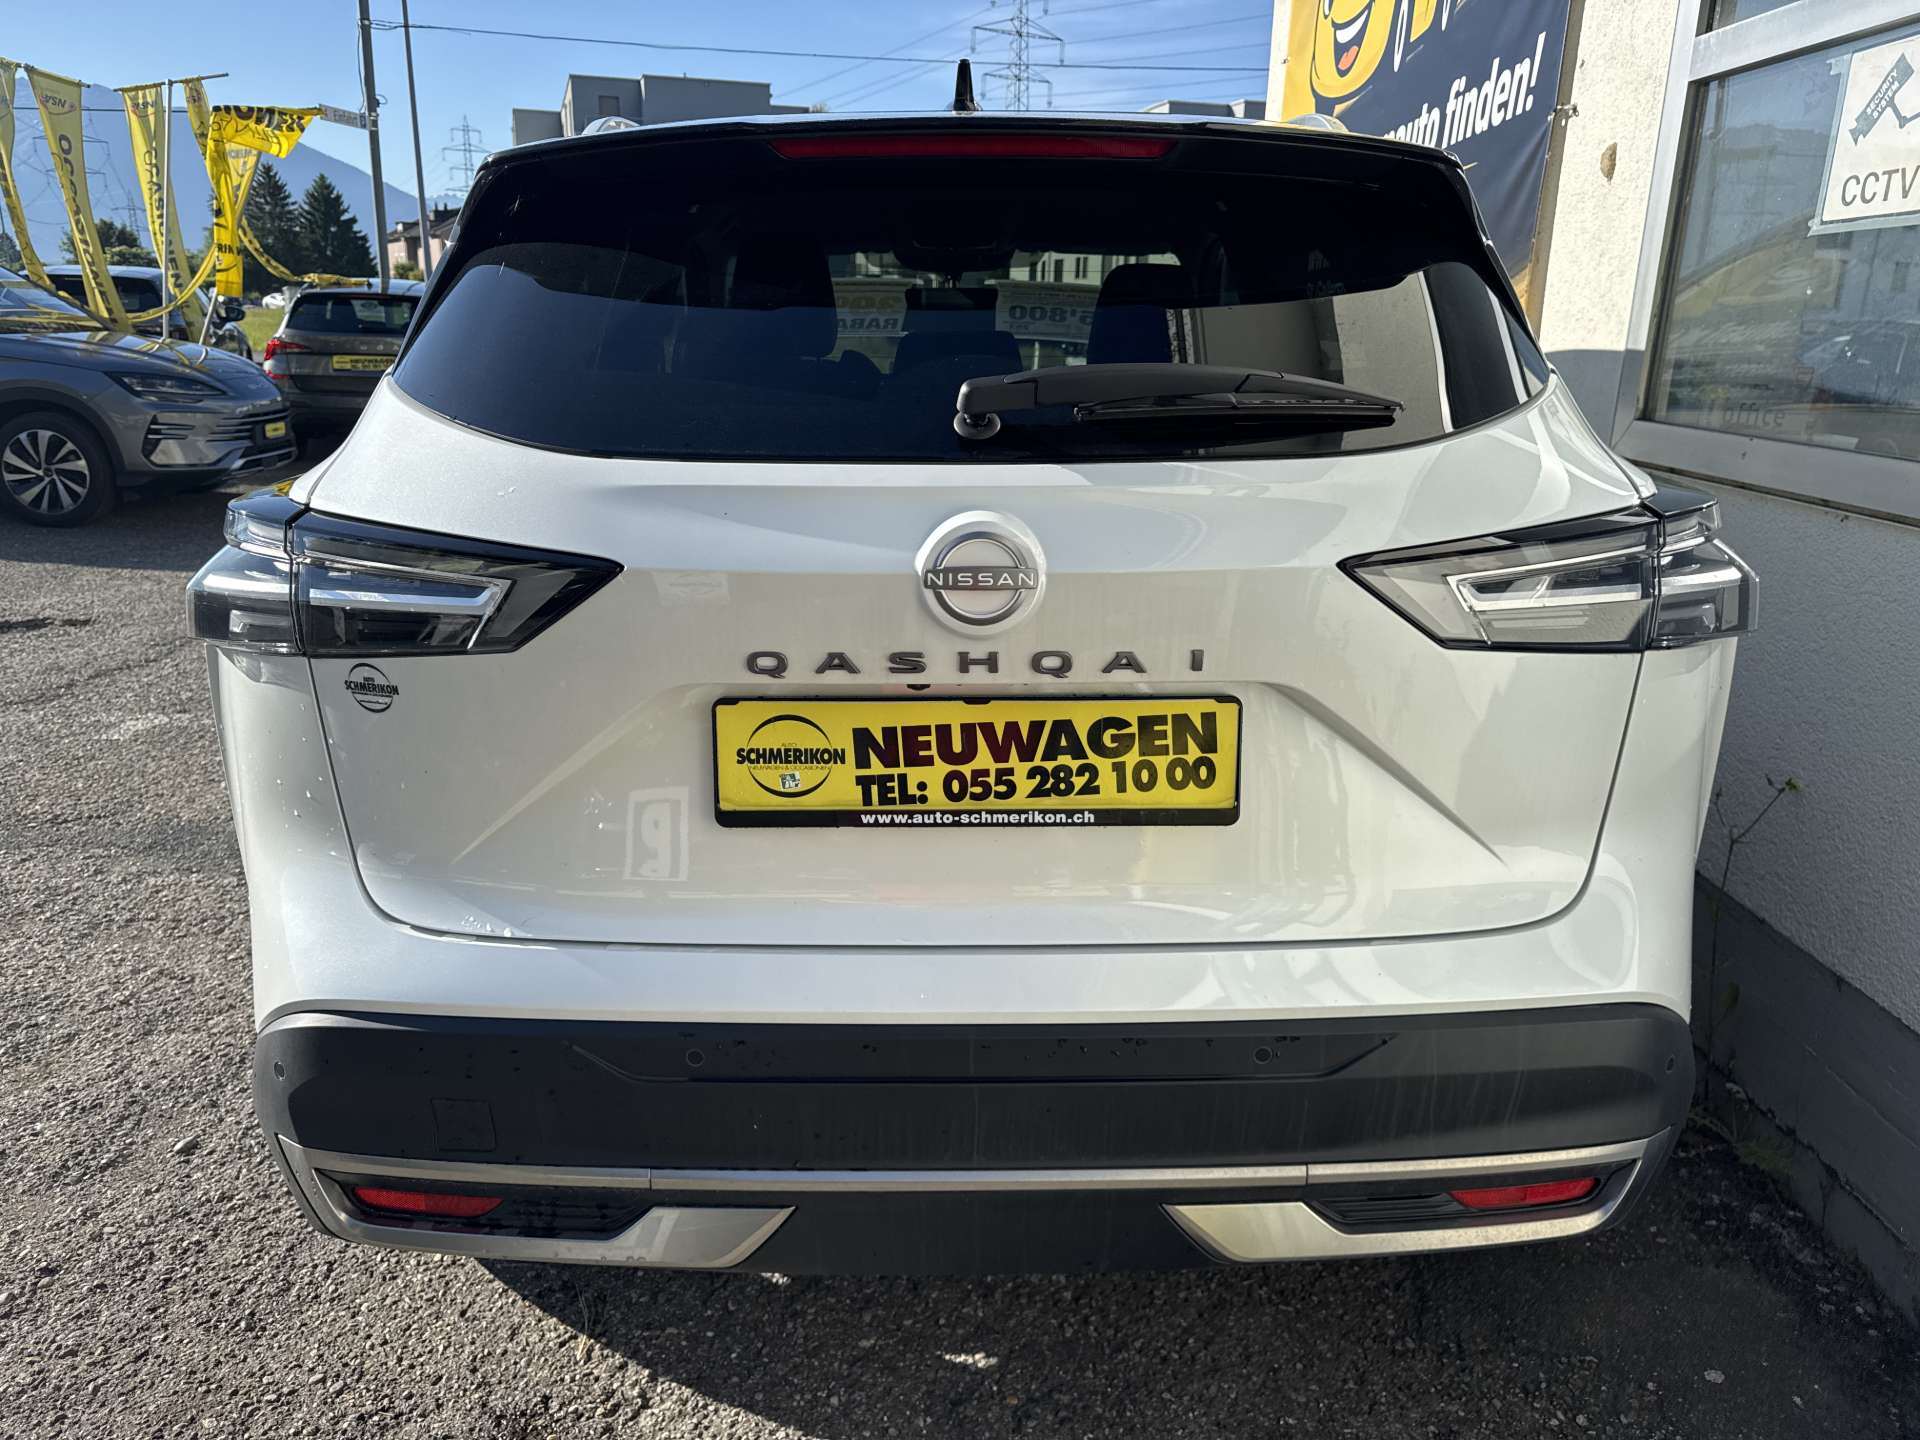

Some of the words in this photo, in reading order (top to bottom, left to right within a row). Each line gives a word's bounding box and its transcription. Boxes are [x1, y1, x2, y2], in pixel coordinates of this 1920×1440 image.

[1442, 31, 1547, 149] finden!
[1866, 69, 1898, 115] SECURITY
[1872, 81, 1900, 119] SYSTEM
[1841, 165, 1920, 207] CCTV
[927, 573, 1034, 586] NISSAN
[745, 650, 1205, 679] QASHQAI
[344, 680, 400, 696] SCHMERIKON
[736, 748, 846, 765] SCHMERIKON
[851, 711, 1218, 769] NEUWAGEN
[855, 773, 929, 806] TEL:
[942, 767, 1018, 802] 055
[1025, 762, 1100, 798] 282
[1112, 759, 1159, 794] 10
[1166, 755, 1217, 790] 00
[860, 811, 1095, 825] www.auto-schmerikon.ch
